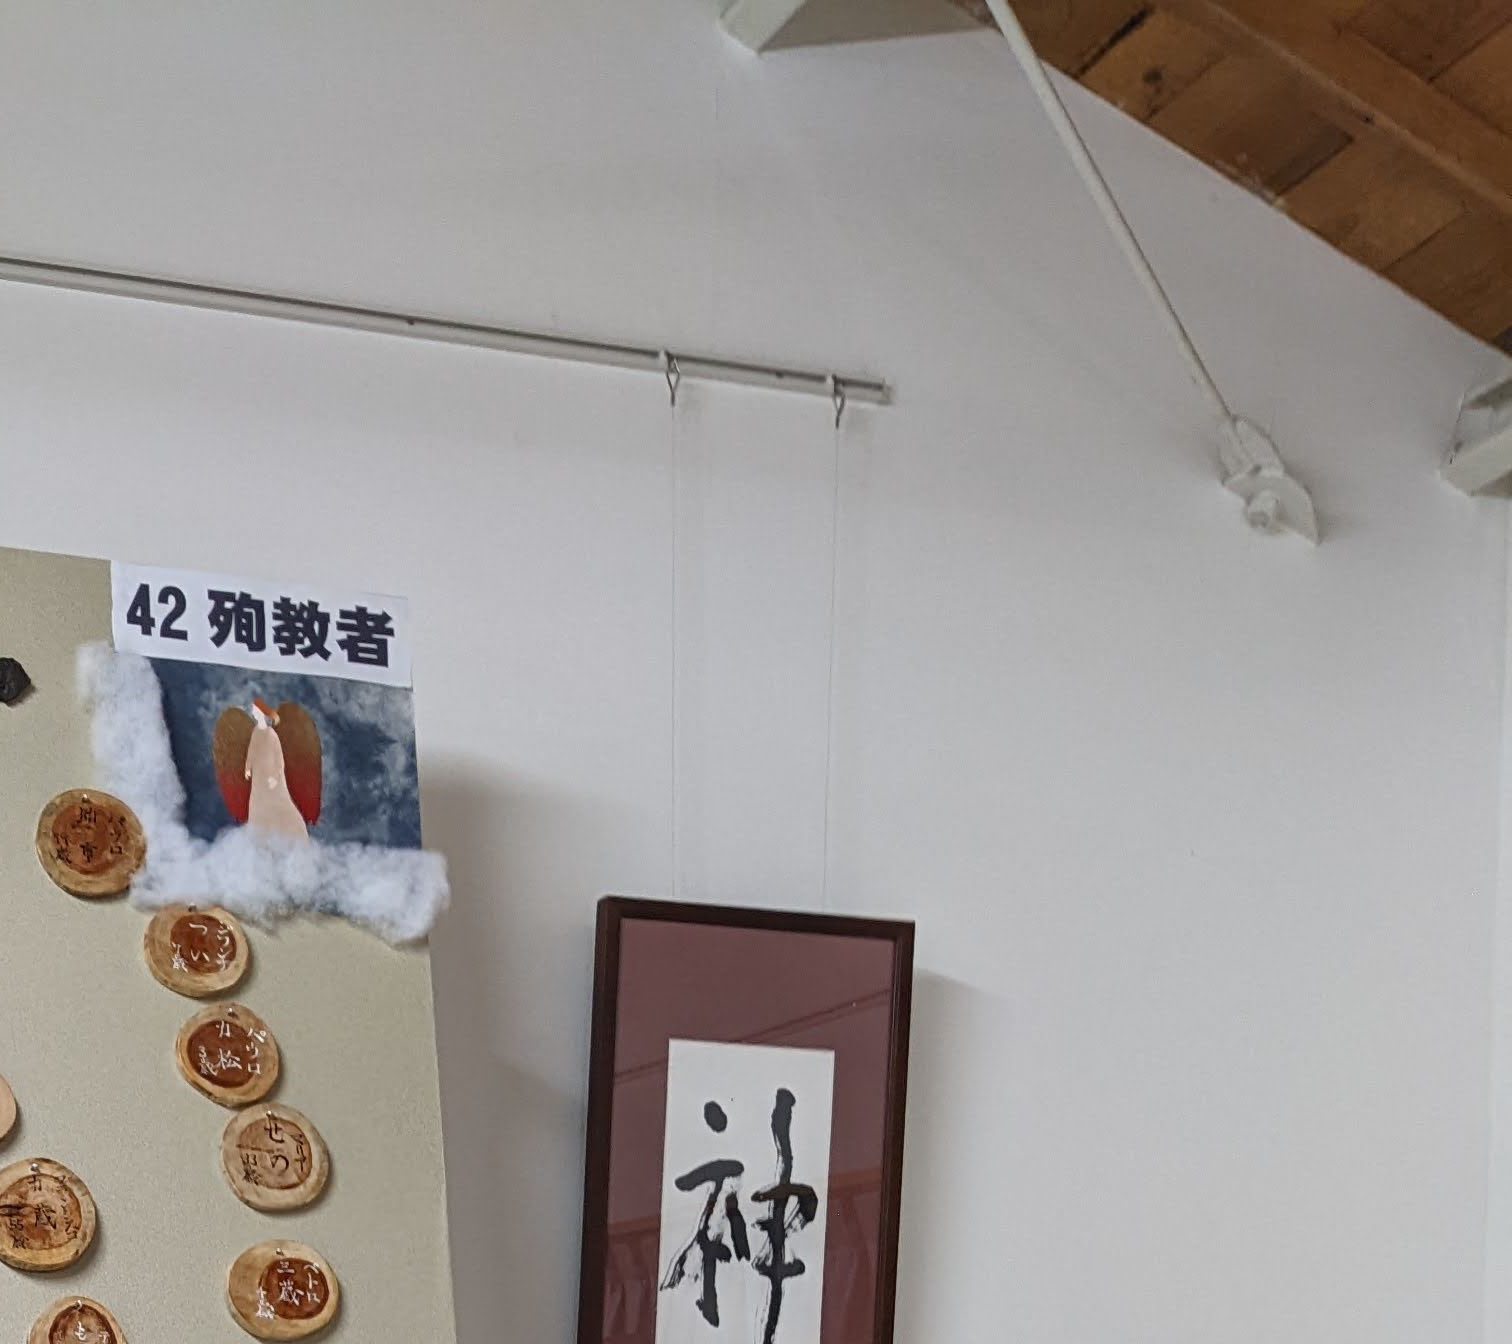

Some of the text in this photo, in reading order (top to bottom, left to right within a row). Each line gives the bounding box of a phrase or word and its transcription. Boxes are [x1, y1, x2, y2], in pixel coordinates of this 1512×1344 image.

[125, 583, 398, 667] 42 殉教者
